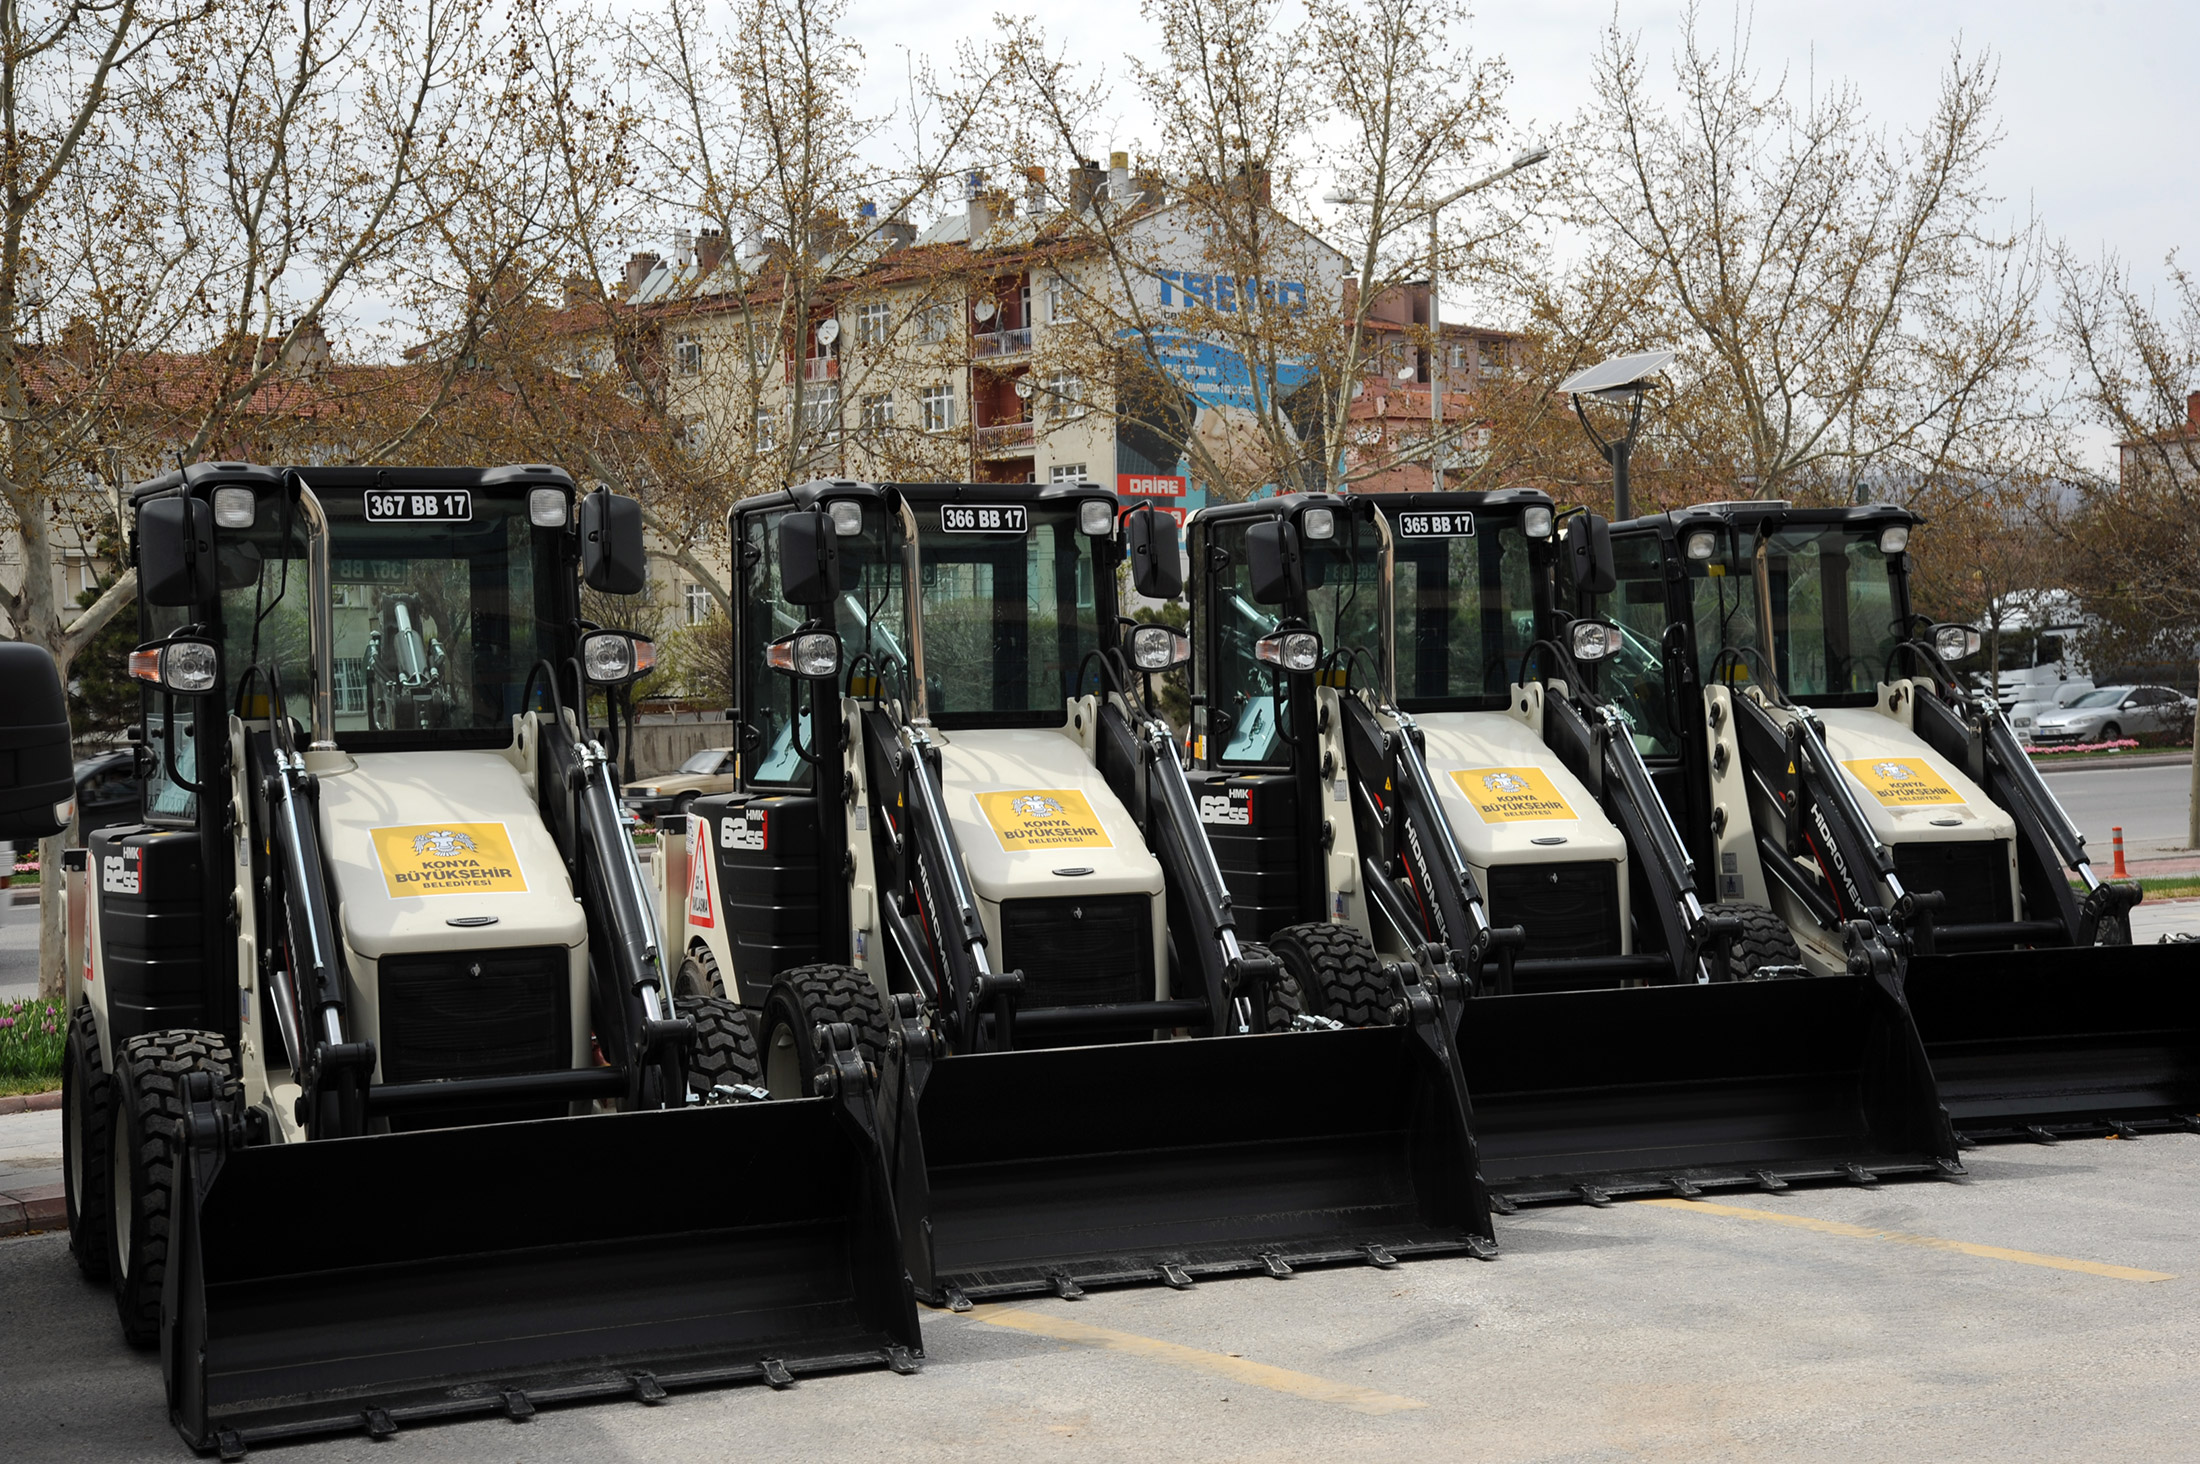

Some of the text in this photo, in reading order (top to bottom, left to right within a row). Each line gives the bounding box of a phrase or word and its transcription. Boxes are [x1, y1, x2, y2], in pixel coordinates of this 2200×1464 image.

[1129, 477, 1179, 494] DAİRE
[371, 495, 466, 516] 367 BB 17
[946, 509, 1023, 528] 366 BB 17
[1404, 516, 1470, 533] 365 BB 17
[1229, 789, 1249, 799] HMK
[1496, 794, 1538, 803] KONYA
[746, 809, 765, 821] HMK
[1023, 819, 1071, 829] KONYA
[123, 846, 140, 860] HMK
[422, 859, 480, 869] KONYA
